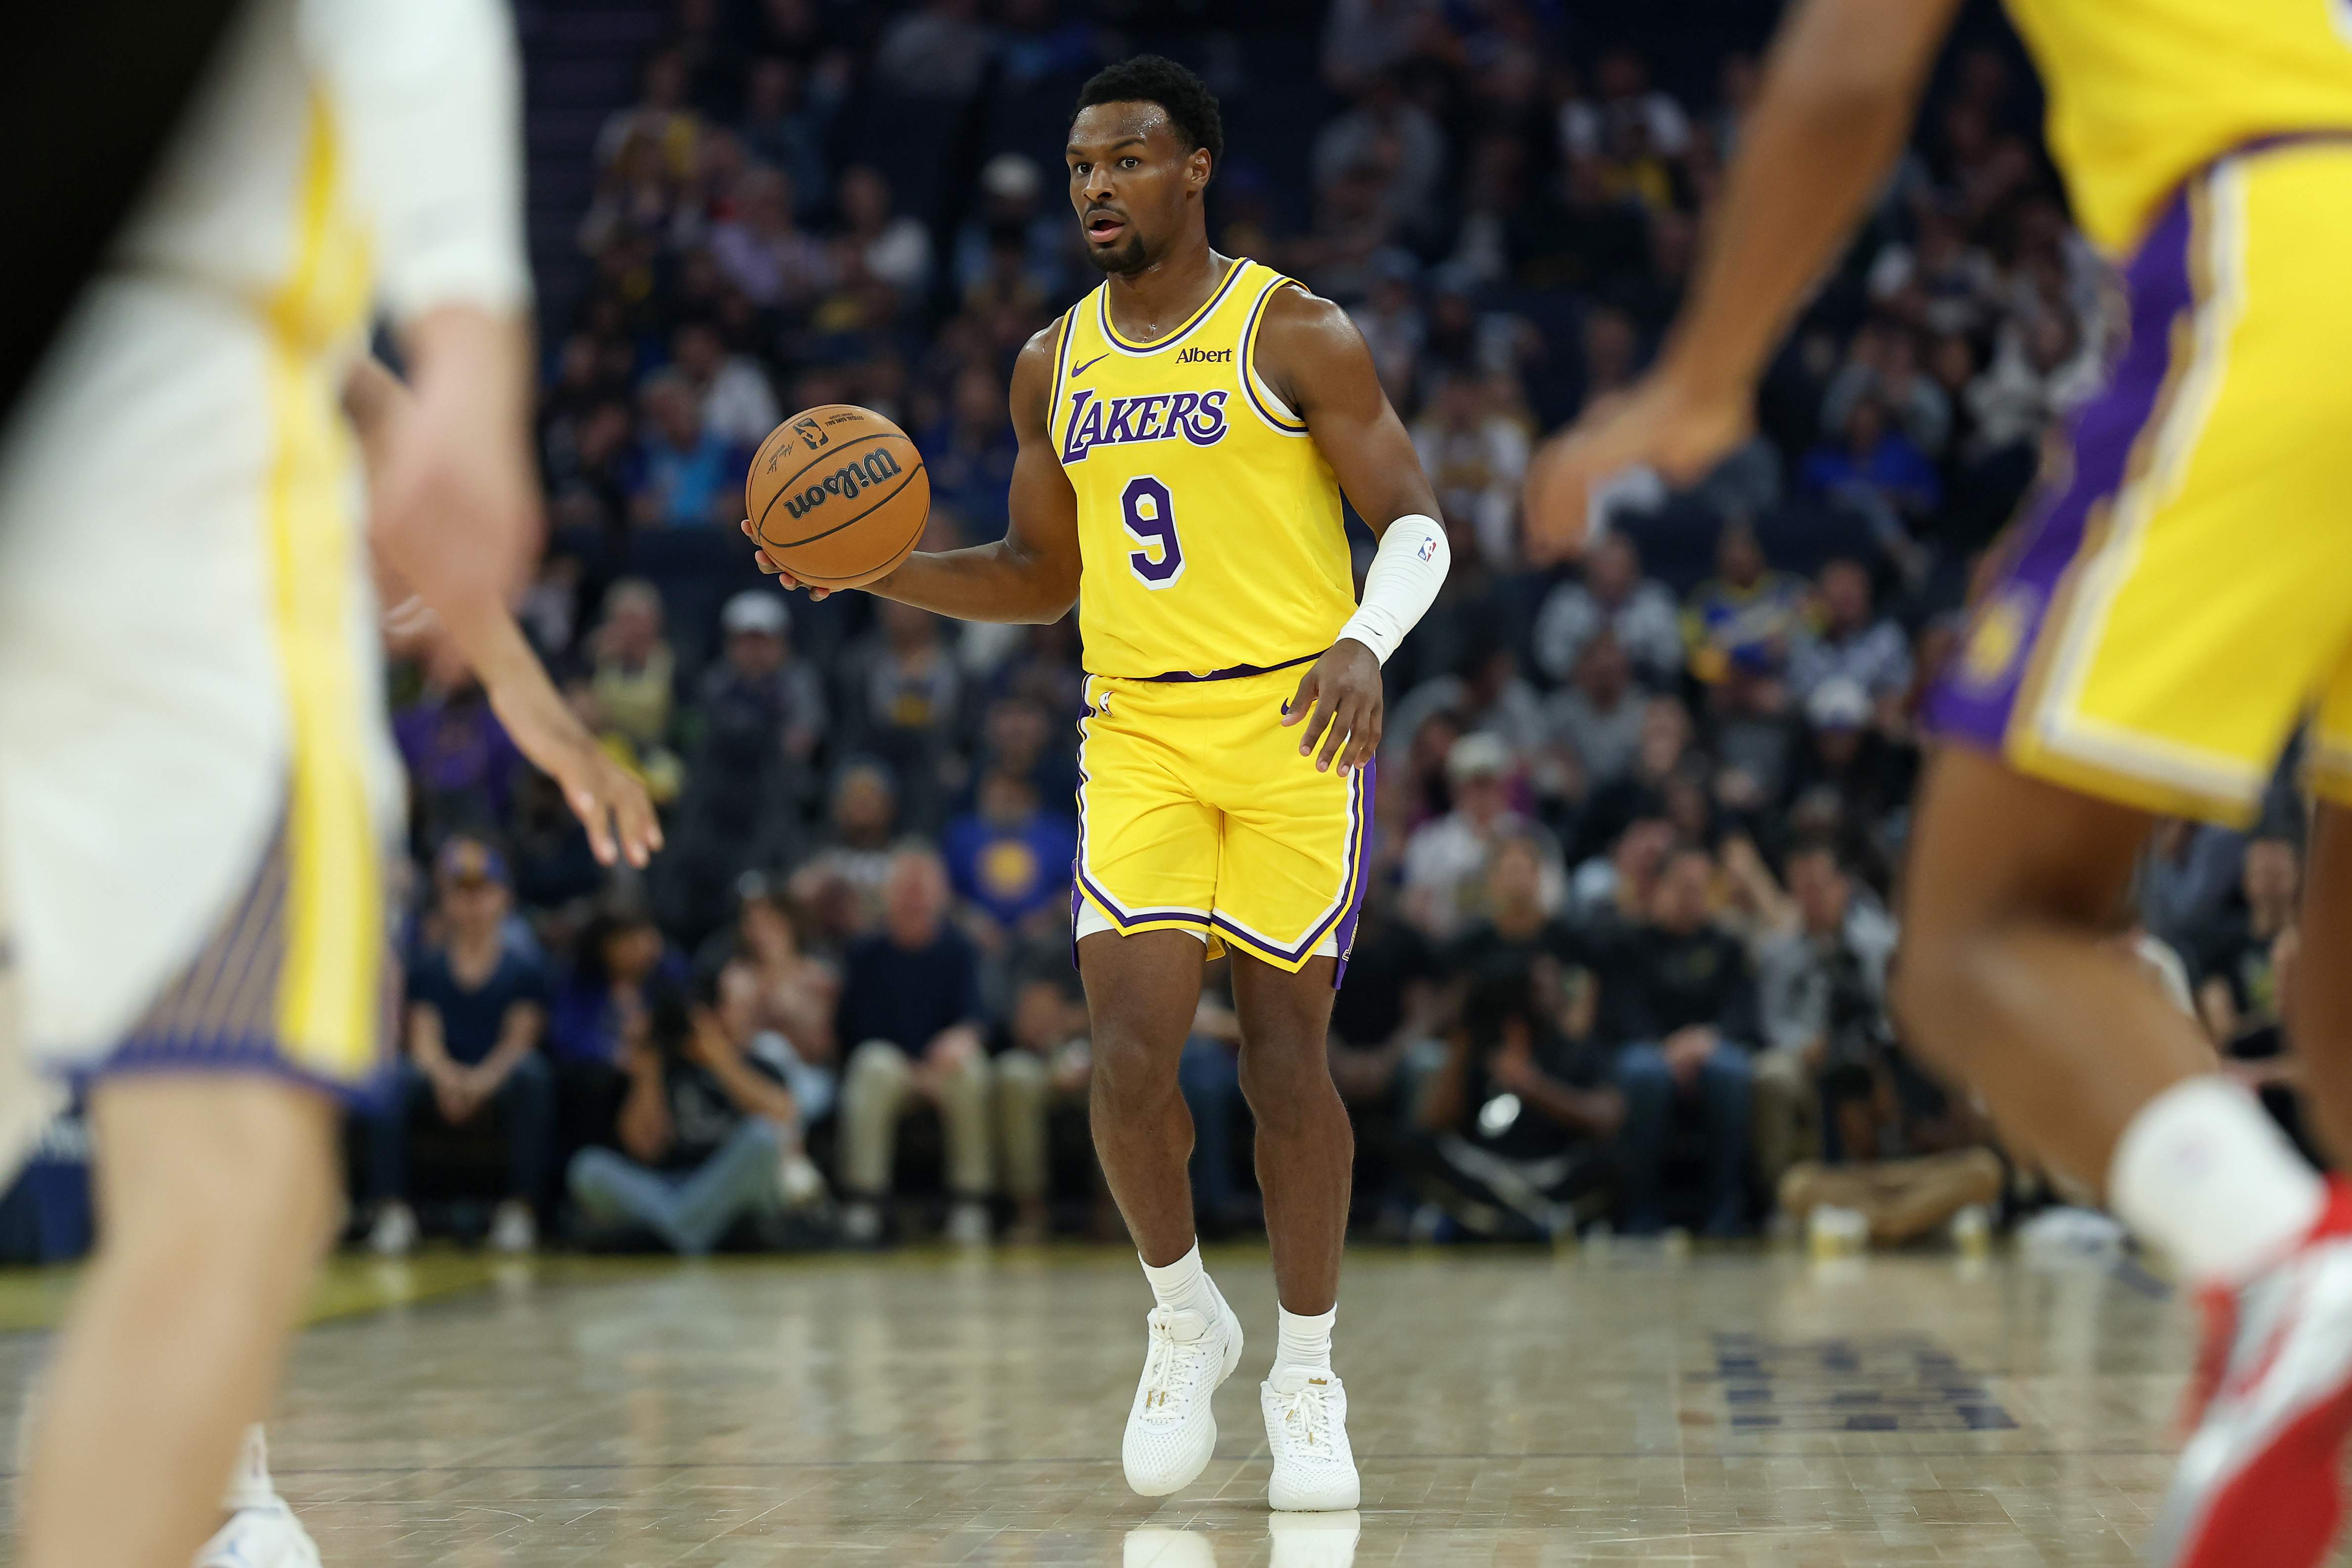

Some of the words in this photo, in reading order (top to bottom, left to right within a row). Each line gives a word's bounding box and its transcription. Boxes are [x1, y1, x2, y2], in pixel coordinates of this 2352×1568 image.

[1175, 347, 1232, 363] Albert
[1062, 387, 1231, 467] LAKERS
[784, 448, 901, 519] Wilson
[1121, 474, 1186, 590] 9
